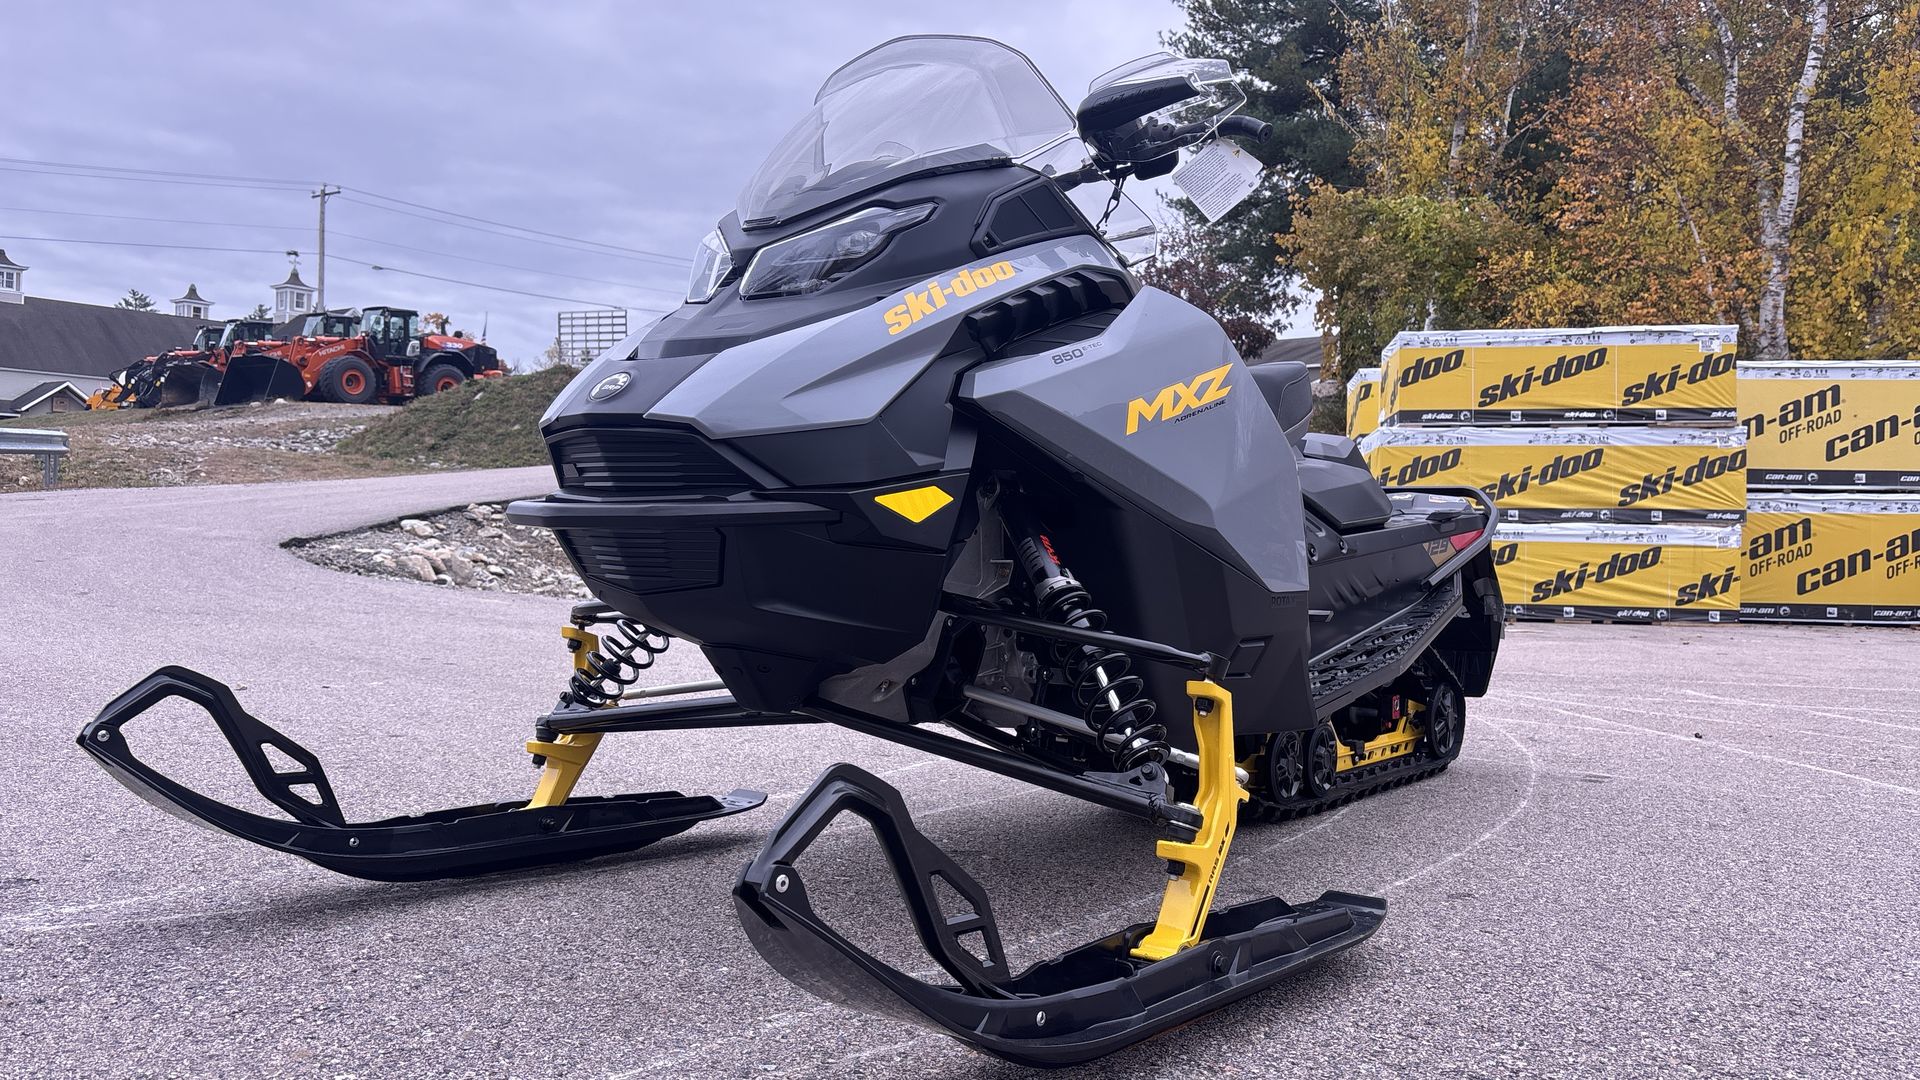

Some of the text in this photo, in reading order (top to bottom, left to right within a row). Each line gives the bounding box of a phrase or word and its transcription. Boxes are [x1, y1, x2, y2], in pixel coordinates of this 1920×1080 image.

[883, 261, 1016, 336] ski-doo
[319, 344, 345, 357] HITACHI
[1052, 348, 1084, 365] 850
[1477, 347, 1608, 408] ski-doo
[1126, 362, 1234, 436] MXZ
[1621, 352, 1737, 407] ski-do
[1174, 399, 1227, 424] ADRENALINE
[1779, 409, 1842, 444] OFF-ROAD
[1617, 448, 1747, 507] ski-doo
[1764, 473, 1804, 481] can-am
[1530, 546, 1663, 603] ski-doo
[1749, 542, 1813, 578] OFF-ROAD
[1796, 528, 1920, 596] can-a
